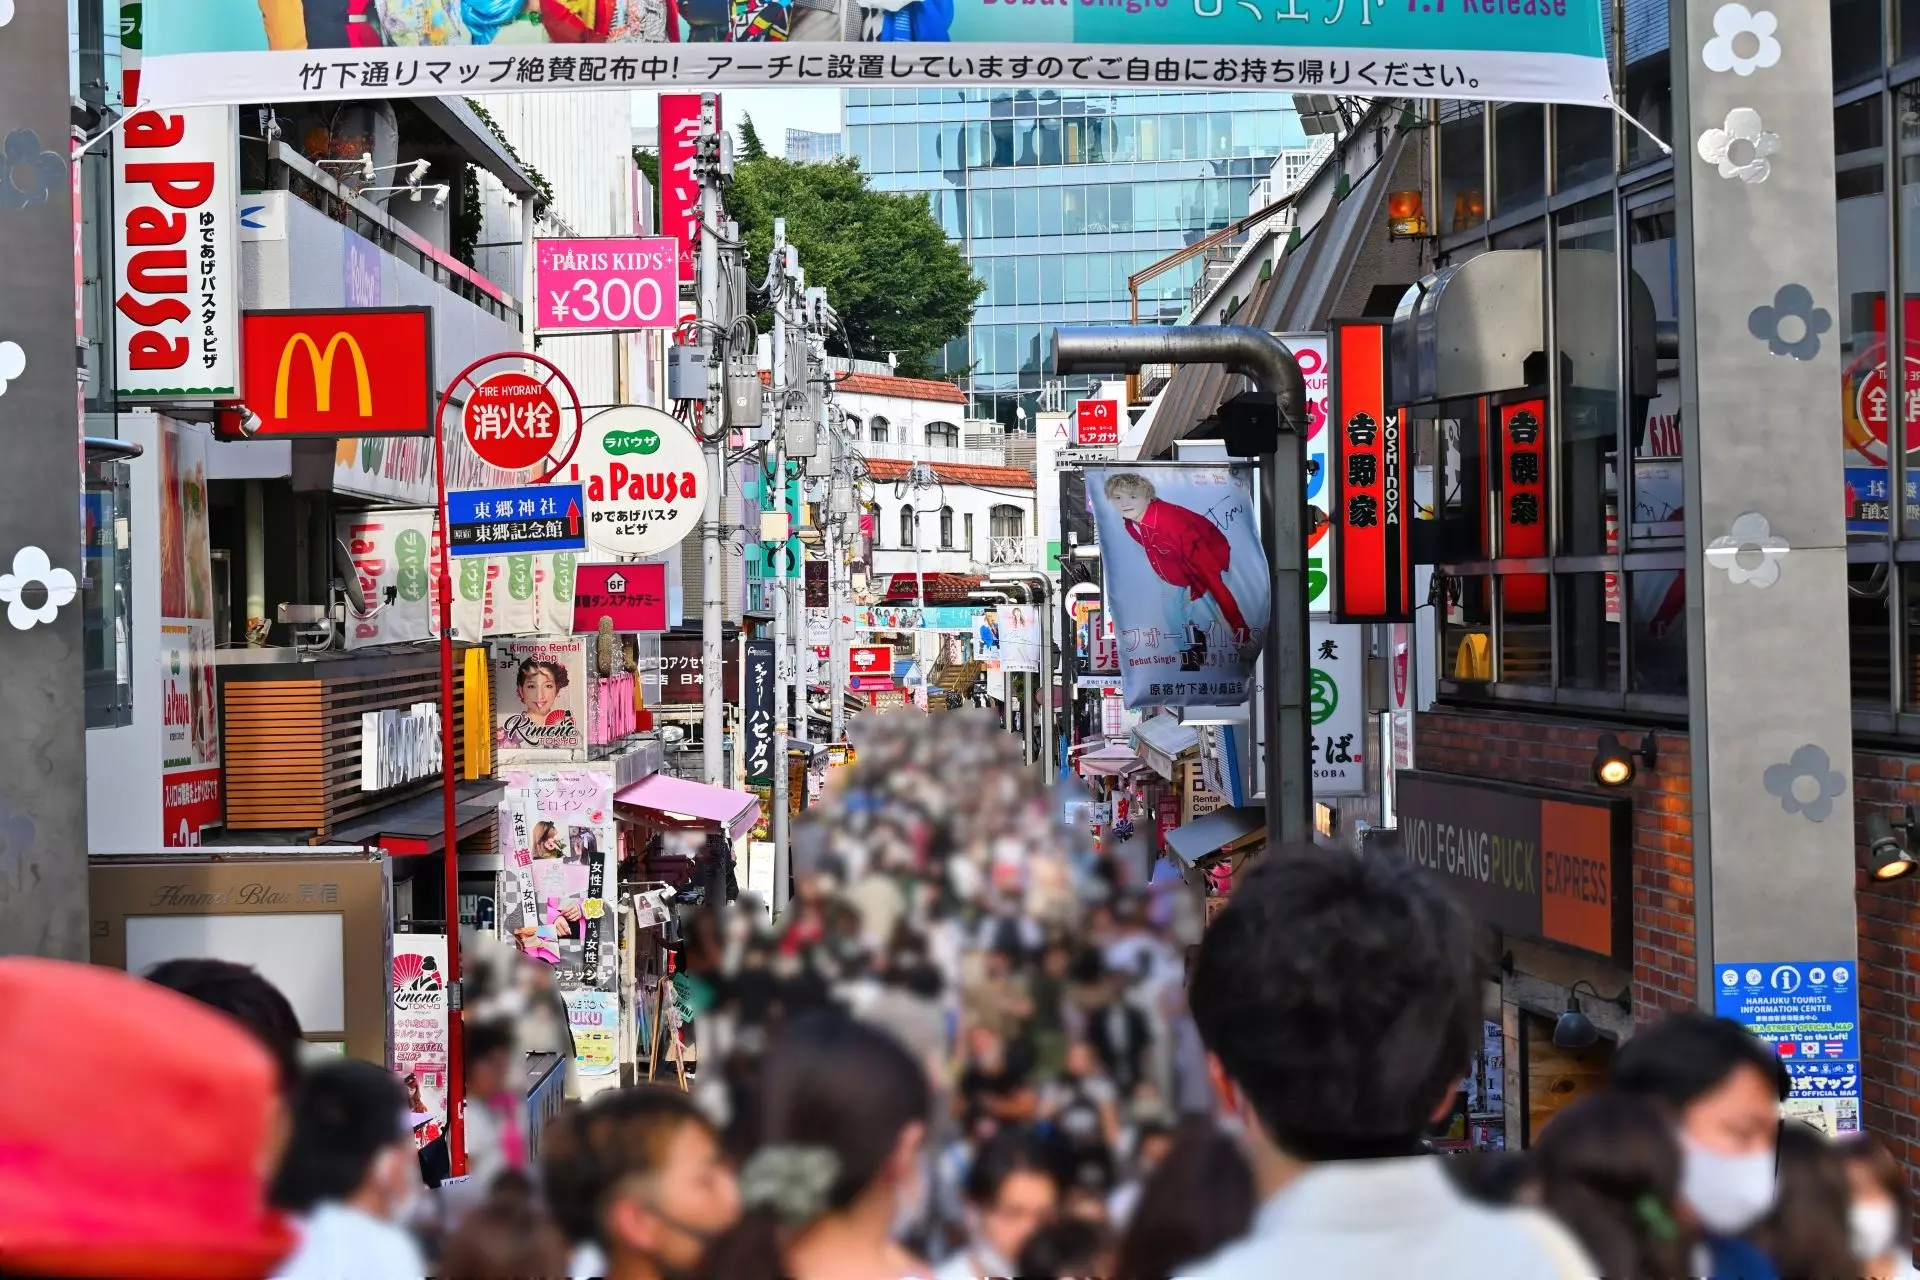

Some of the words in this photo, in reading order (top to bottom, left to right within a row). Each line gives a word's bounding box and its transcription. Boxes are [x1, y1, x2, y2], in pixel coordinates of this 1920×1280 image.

[298, 53, 679, 91] 竹下通りマップ絶賛配布中!
[706, 54, 1480, 89] アーチに設置していますのでご自由にお持ち帰りください。
[116, 161, 215, 370] Pausa
[552, 247, 608, 271] PARIS
[612, 253, 663, 271] KID'S
[199, 212, 218, 369] ゆであげパスタ&ピザ
[551, 277, 662, 322] ¥300
[479, 386, 498, 397] FIRE
[502, 384, 543, 397] HYDRANT
[472, 401, 554, 441] 消火栓
[605, 436, 658, 449] ラパウザ
[1088, 432, 1118, 442] アガサ
[1346, 411, 1378, 528] 吉野家
[610, 462, 697, 504] Pausa
[473, 497, 557, 520] 東郷神社
[591, 508, 678, 523] ゆであげパスタ
[475, 520, 563, 542] 東郷記念館
[616, 523, 647, 536] &ピザ
[609, 580, 624, 590] 6F
[509, 643, 547, 653] Kimono
[549, 643, 580, 652] Rental
[532, 653, 557, 664] Shop
[1129, 655, 1151, 667] Debut
[1153, 655, 1176, 665] Single
[749, 710, 770, 778] ハセガワ
[520, 787, 597, 798] ロマンティック
[536, 800, 583, 811] ヒロイン
[1404, 817, 1489, 883] WOLFGANG
[1491, 834, 1536, 896] PUCK
[1544, 850, 1608, 906] EXPRESS
[1746, 997, 1790, 1005] HARAJUKU
[1792, 996, 1827, 1004] TOURIST
[1741, 1005, 1798, 1013] INFORMATION
[1800, 1004, 1832, 1012] CENTER
[1790, 1033, 1802, 1041] TIC
